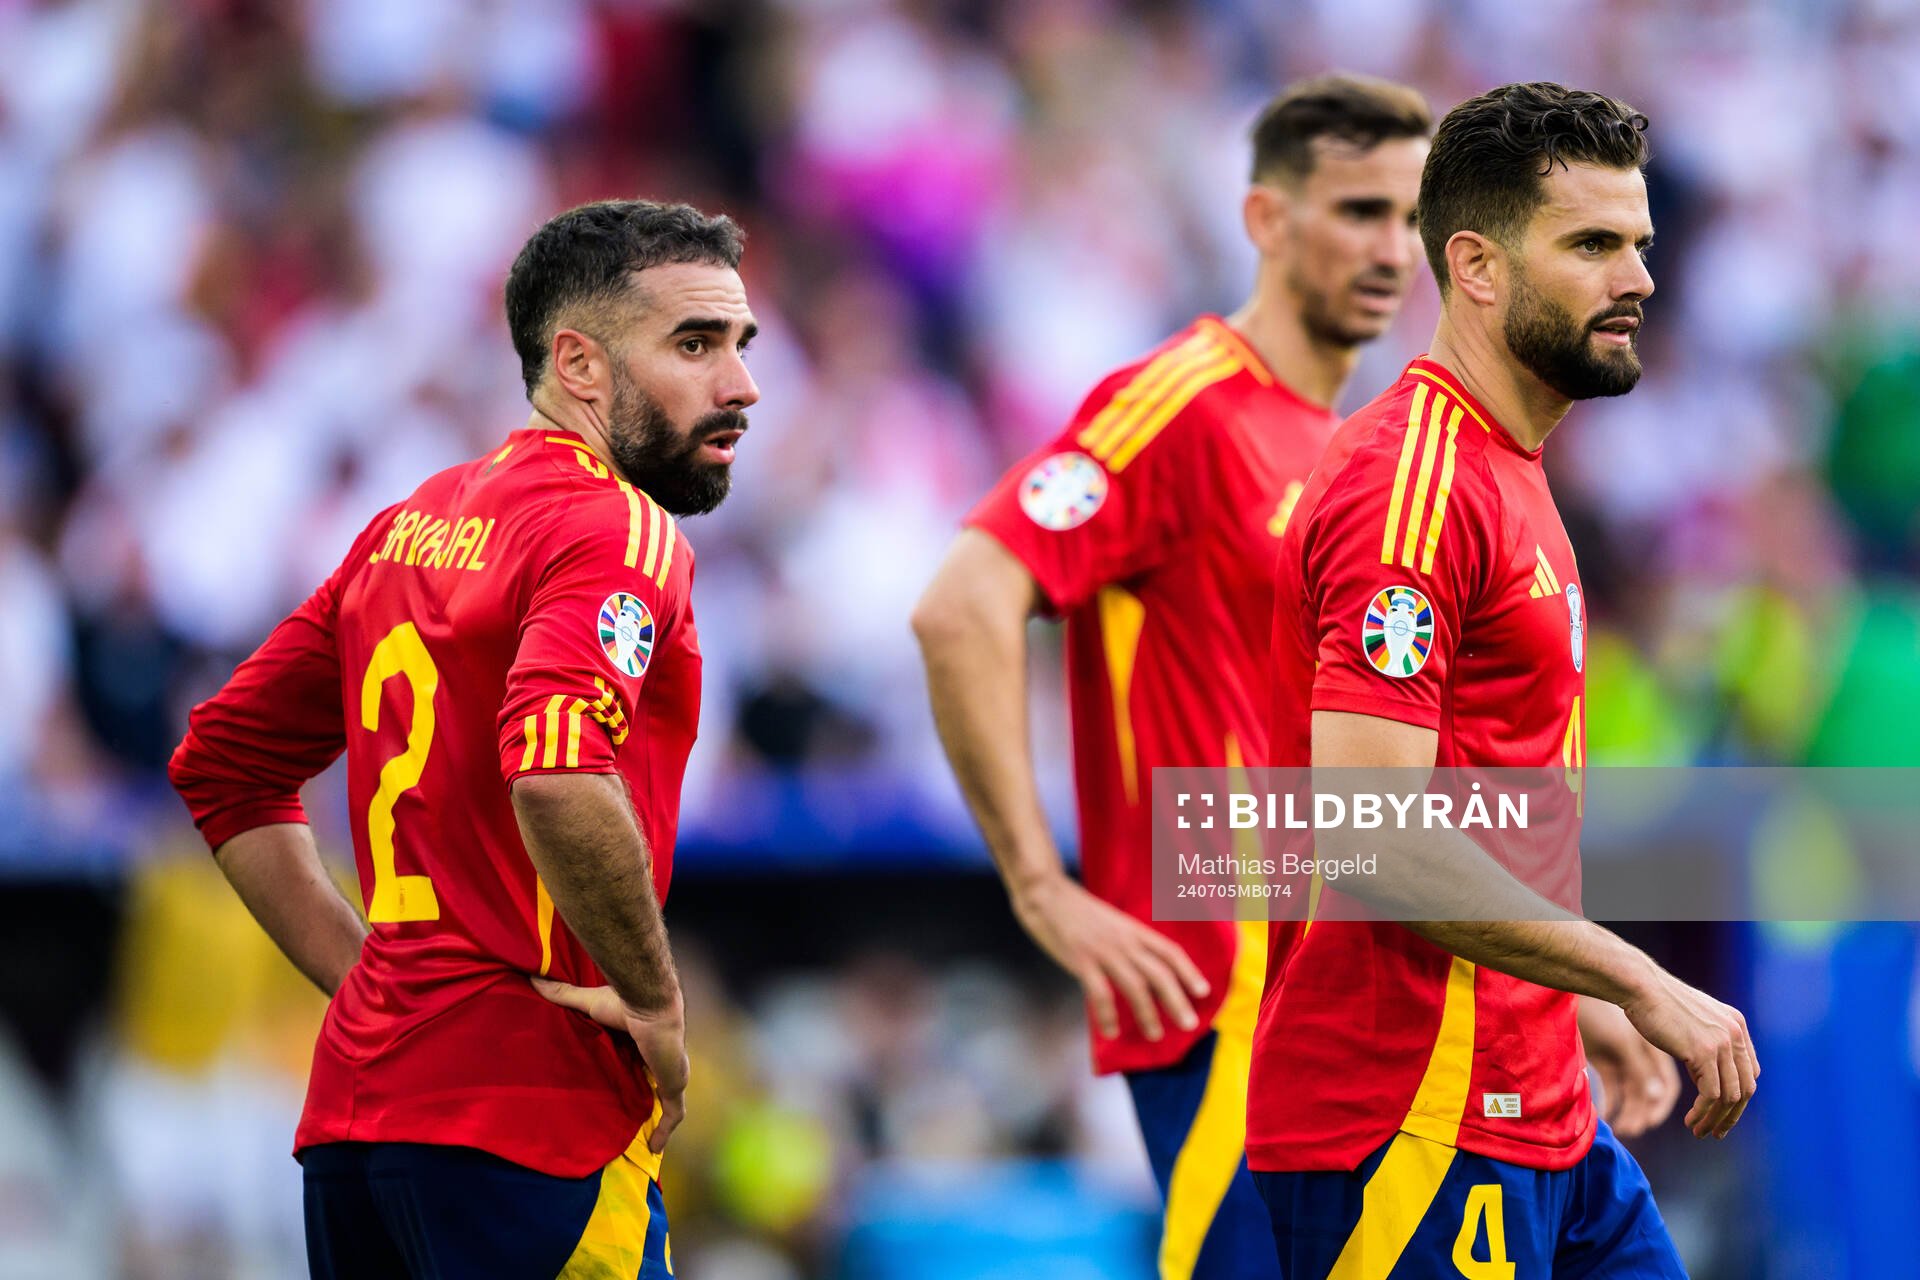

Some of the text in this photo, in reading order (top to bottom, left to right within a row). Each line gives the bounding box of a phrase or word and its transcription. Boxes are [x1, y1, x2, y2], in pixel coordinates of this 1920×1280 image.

[369, 509, 496, 572] ARVAJAL
[361, 621, 440, 923] 2
[1452, 1184, 1516, 1280] 4
